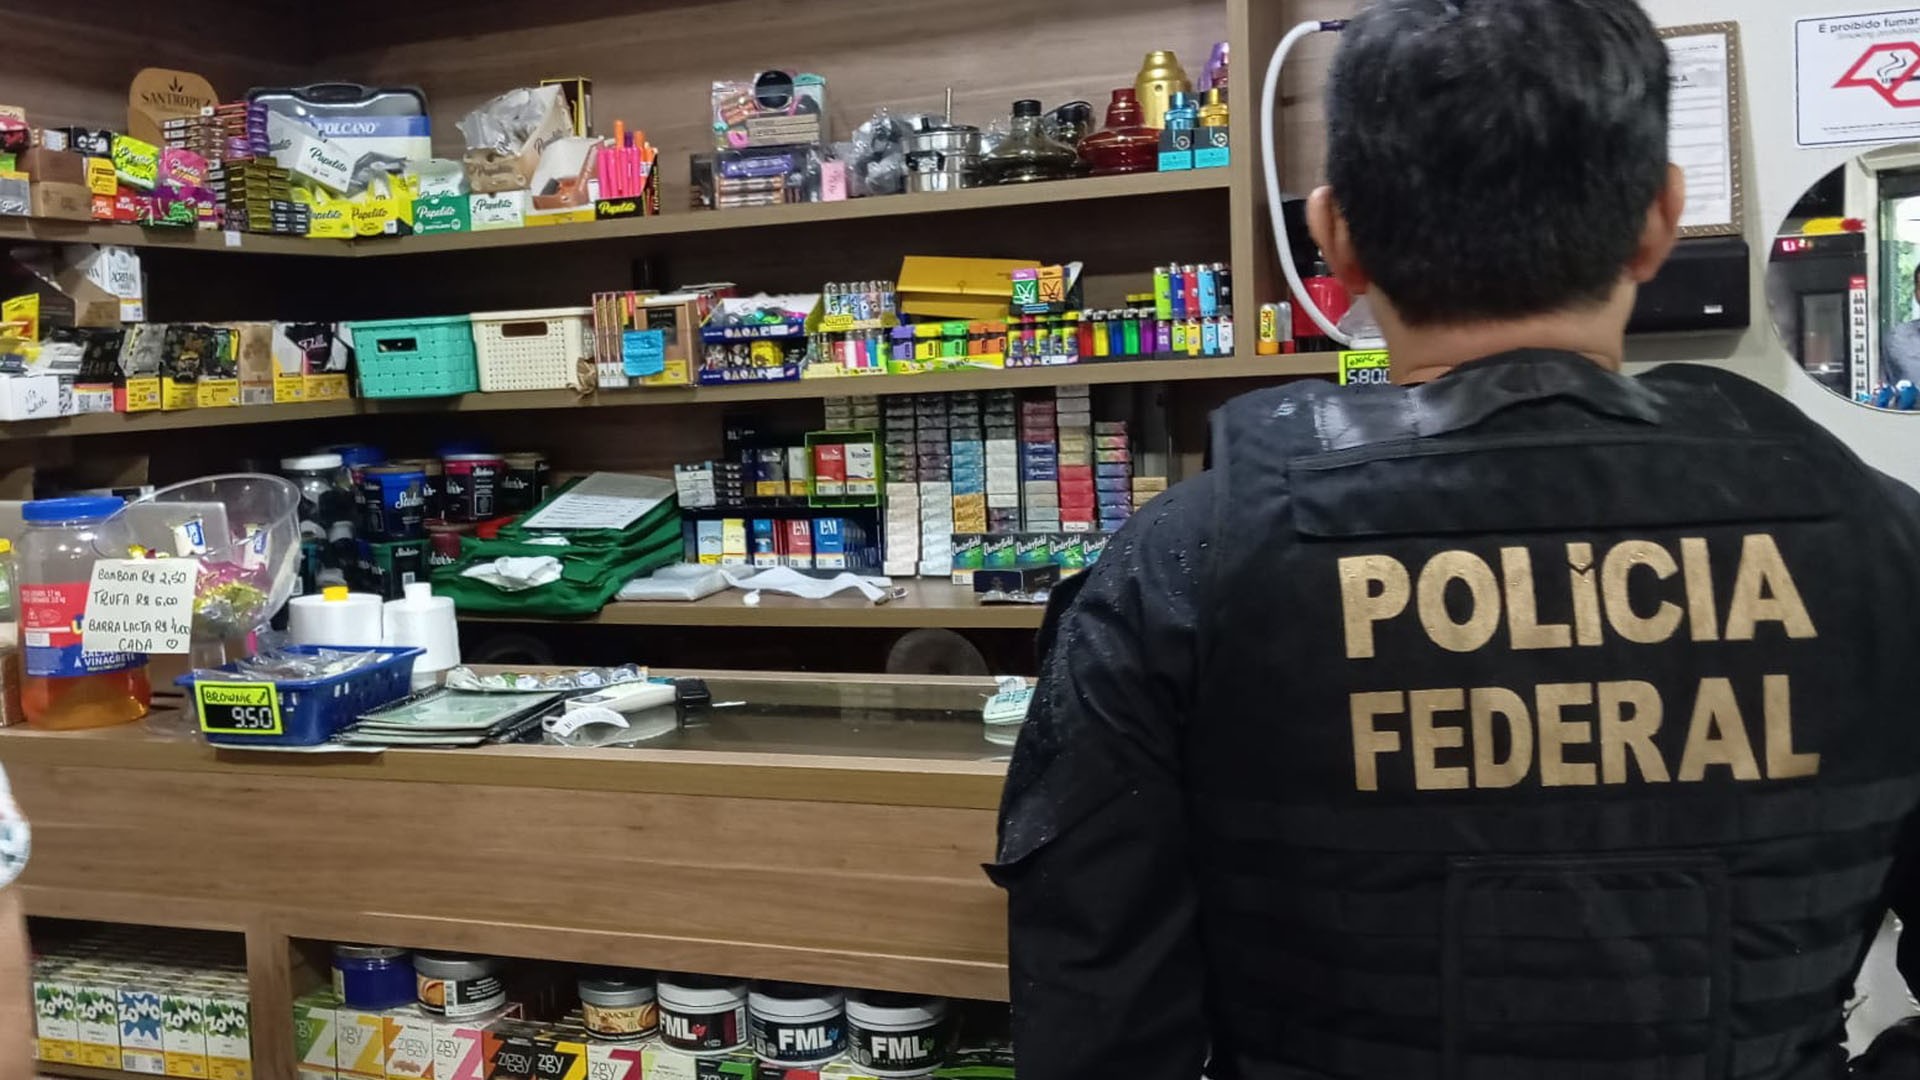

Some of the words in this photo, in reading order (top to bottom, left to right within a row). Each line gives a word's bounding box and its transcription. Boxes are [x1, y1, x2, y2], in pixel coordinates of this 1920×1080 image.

[1830, 20, 1881, 33] proibido
[94, 589, 130, 606] TRUFA
[88, 618, 121, 633] BARRA
[123, 620, 152, 633] LACTA
[118, 638, 153, 651] CADA
[1349, 674, 1820, 791] FEDERAL
[38, 995, 74, 1016] ZOMO
[79, 998, 115, 1020] ZOMO
[118, 999, 161, 1023] ZOMO
[162, 1007, 201, 1029] ZOMO
[205, 1011, 246, 1032] ZOMO
[659, 1009, 698, 1041] FML
[778, 1026, 834, 1051] FML
[871, 1035, 929, 1060] FML
